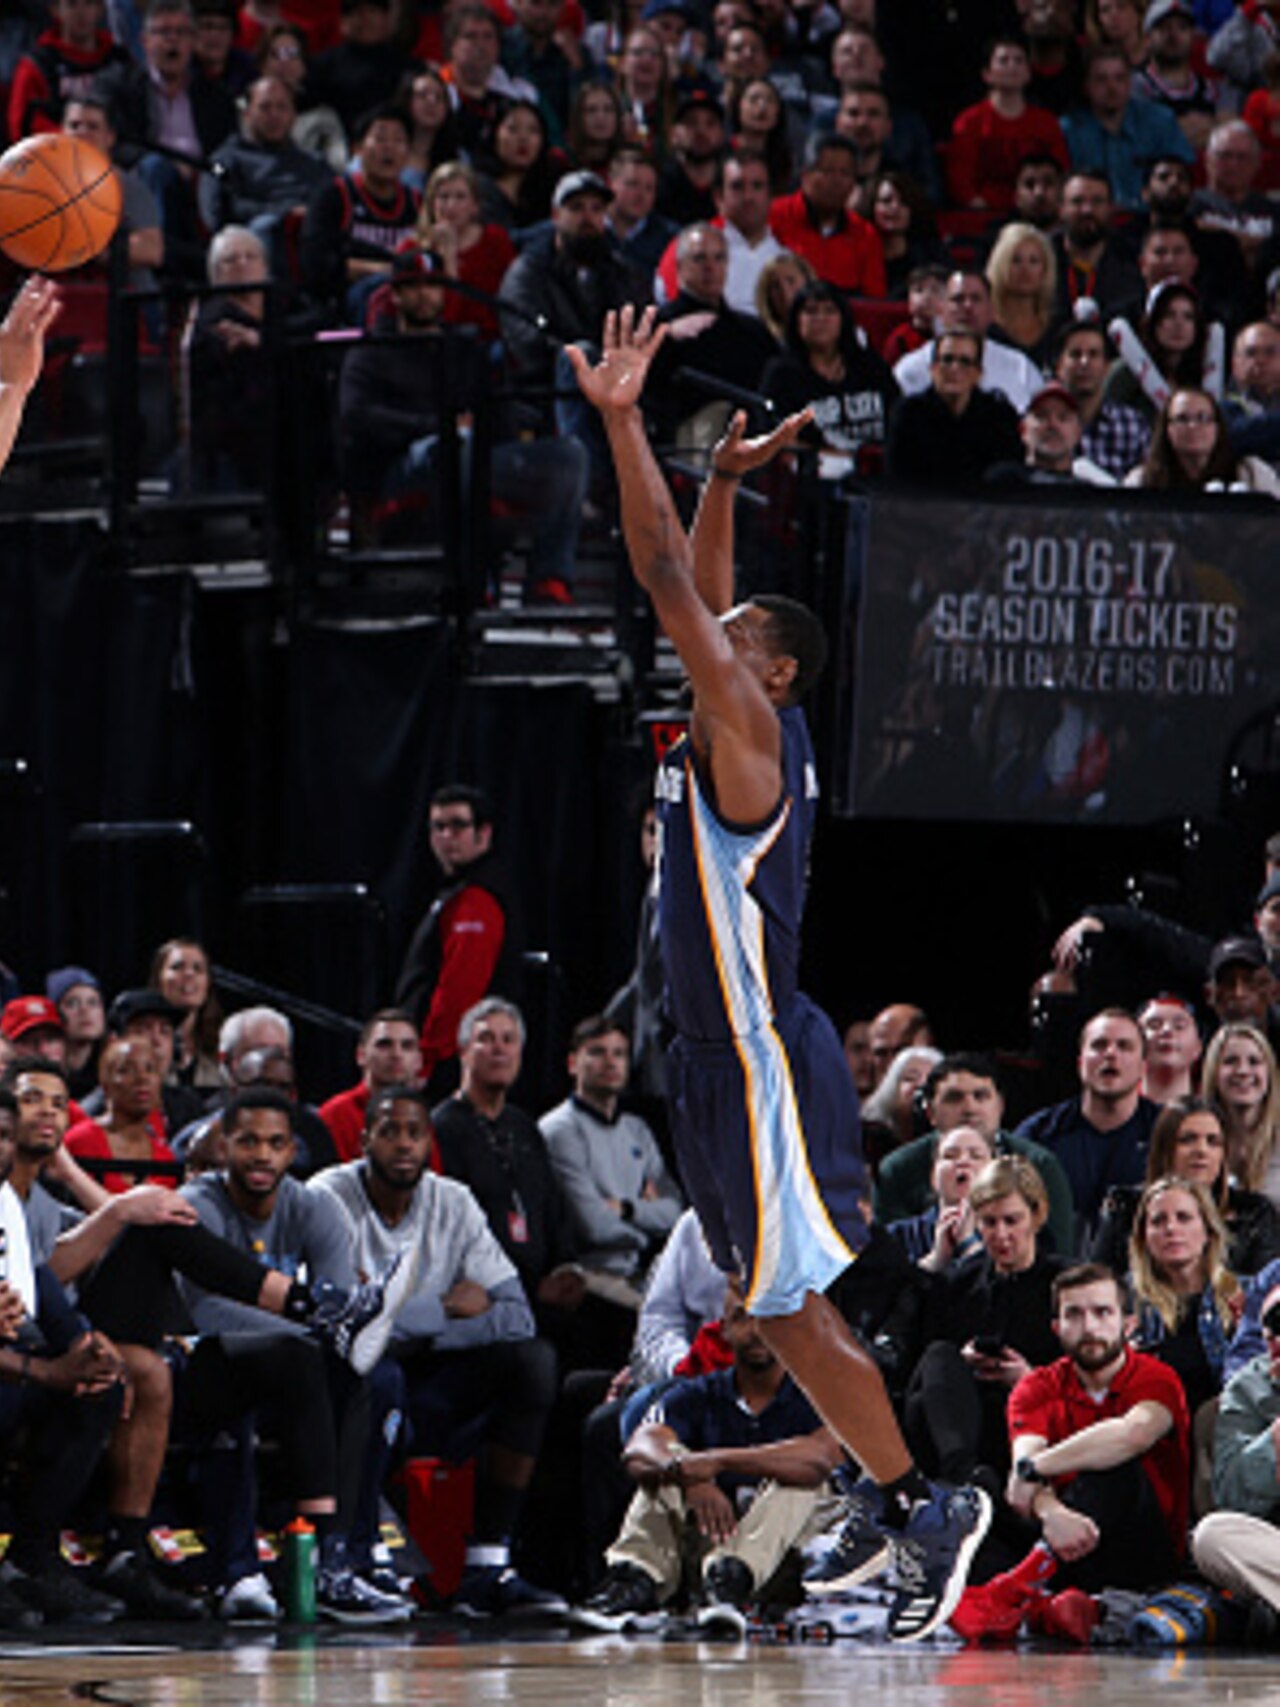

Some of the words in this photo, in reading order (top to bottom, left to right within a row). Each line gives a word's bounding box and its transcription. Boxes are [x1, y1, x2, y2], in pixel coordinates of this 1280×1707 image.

[1004, 536, 1177, 597] 2016-17
[932, 592, 1075, 645] SEASON
[1086, 599, 1238, 650] TICKETS
